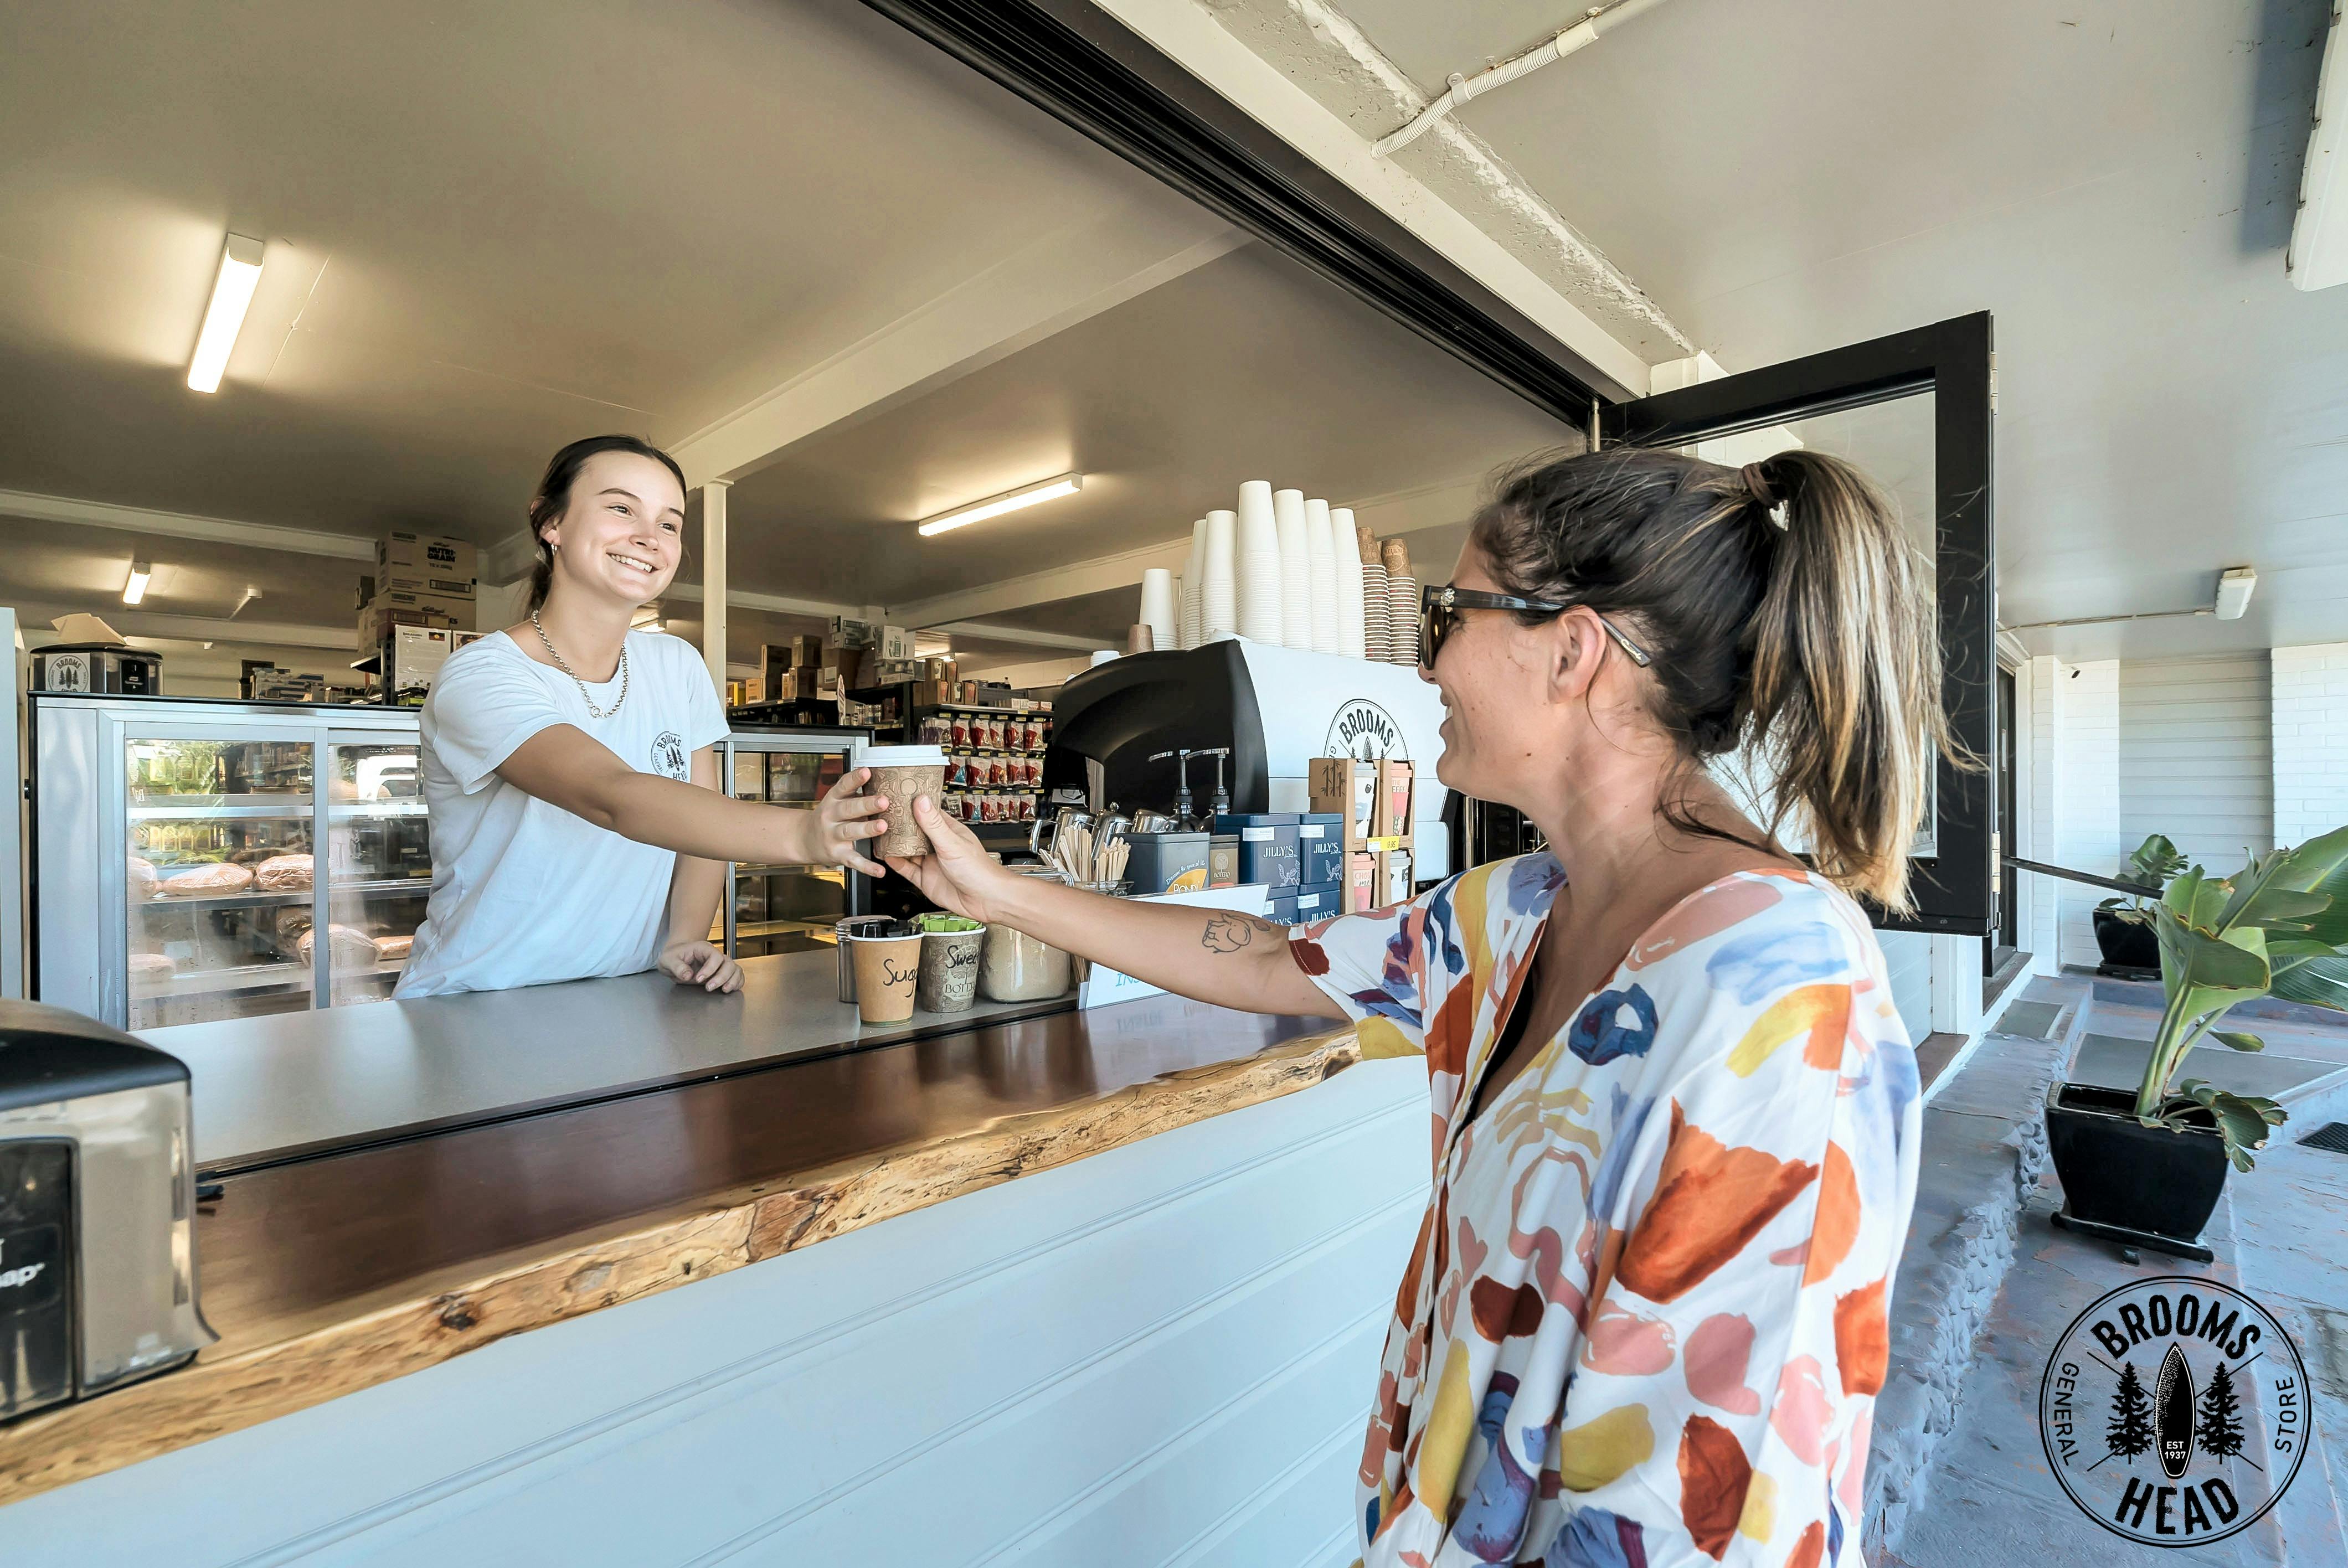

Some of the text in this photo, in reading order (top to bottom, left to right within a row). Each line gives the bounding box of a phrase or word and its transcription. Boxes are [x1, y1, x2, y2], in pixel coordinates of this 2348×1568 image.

[427, 554, 455, 563] GRAIN
[1339, 708, 1393, 747] BROOMS
[653, 753, 664, 772] GENERAL
[1263, 845, 1294, 858] JILLY'S
[1314, 842, 1338, 854] JILLY'S
